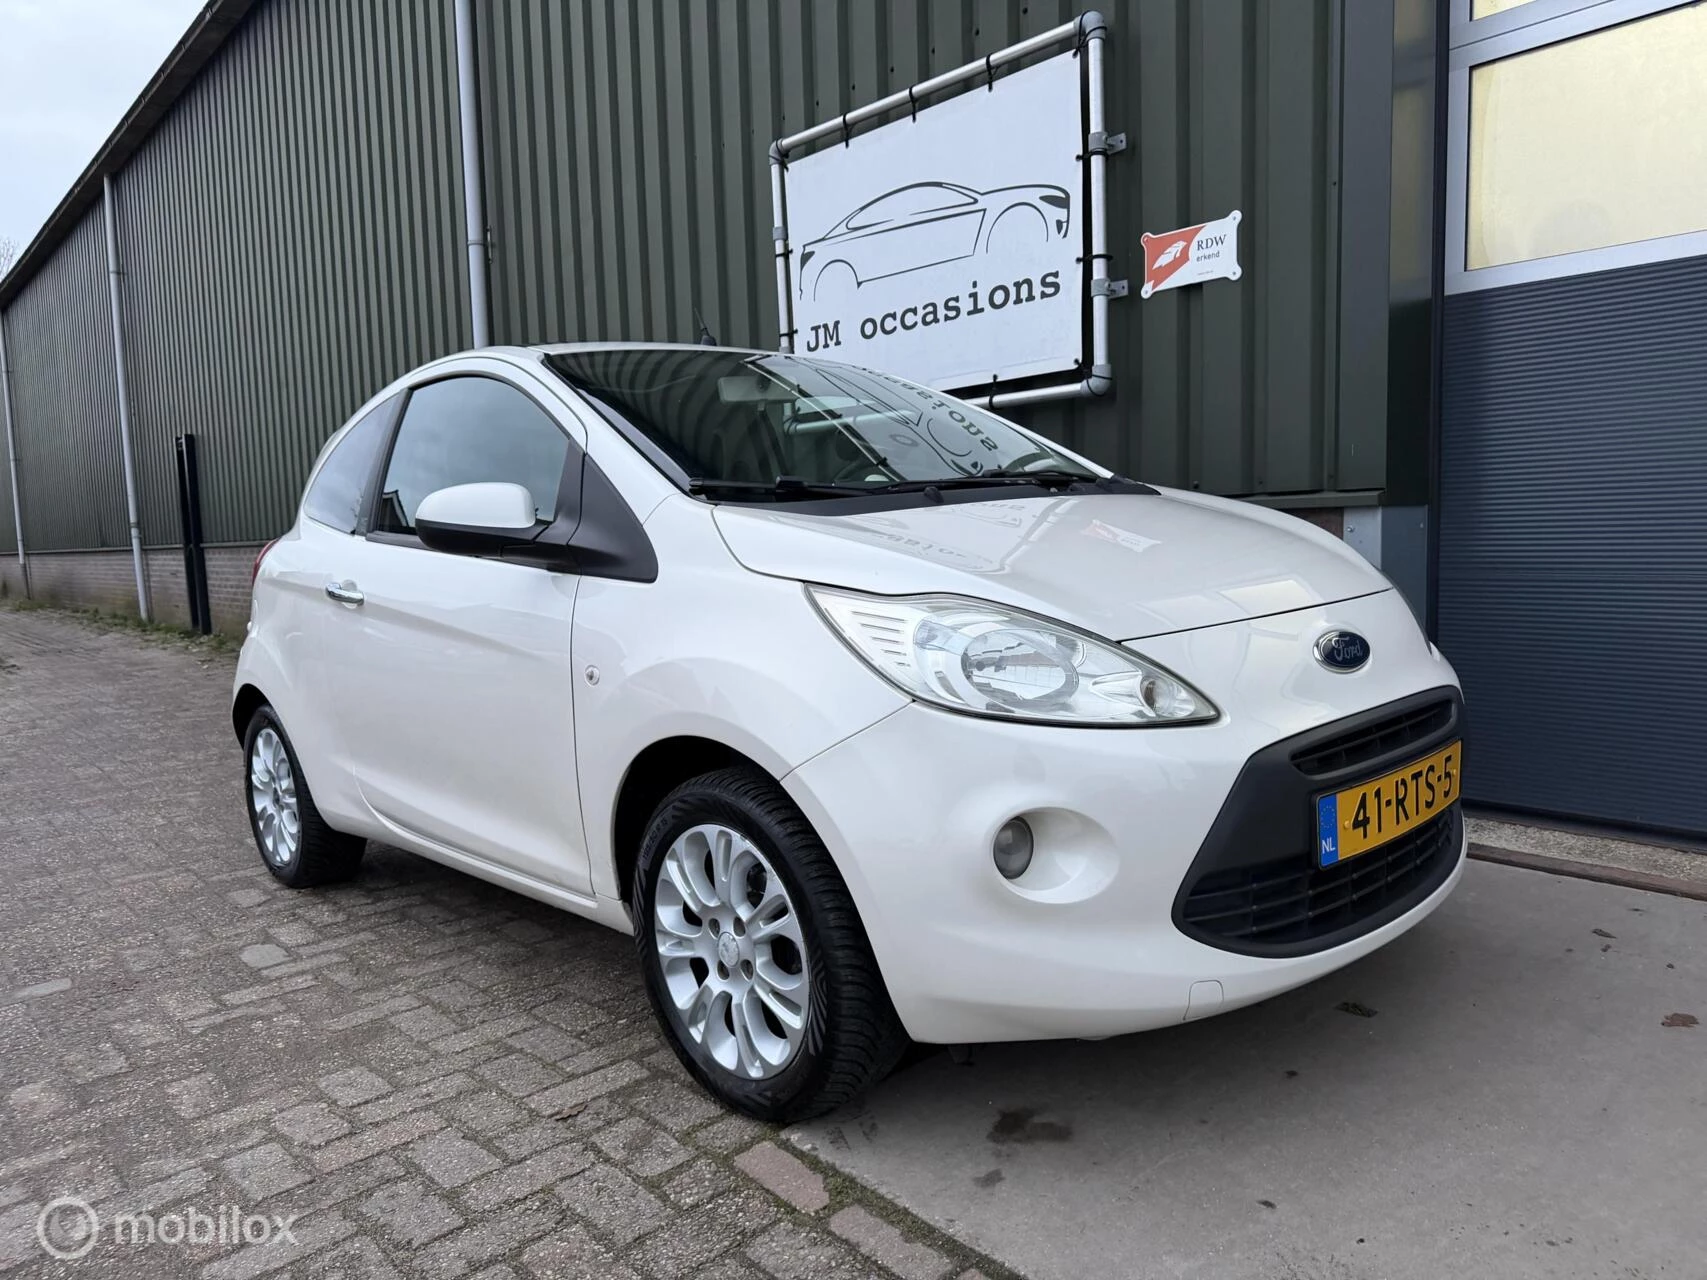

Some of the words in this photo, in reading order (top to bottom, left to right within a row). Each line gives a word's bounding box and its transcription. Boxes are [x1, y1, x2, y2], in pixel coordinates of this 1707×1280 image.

[1197, 234, 1227, 252] RDW
[1197, 251, 1220, 262] erkend
[806, 320, 842, 352] JM
[860, 270, 1061, 340] occasions
[1332, 637, 1363, 661] Ford
[1352, 754, 1452, 840] 41-RTS-5
[1321, 836, 1336, 855] NL
